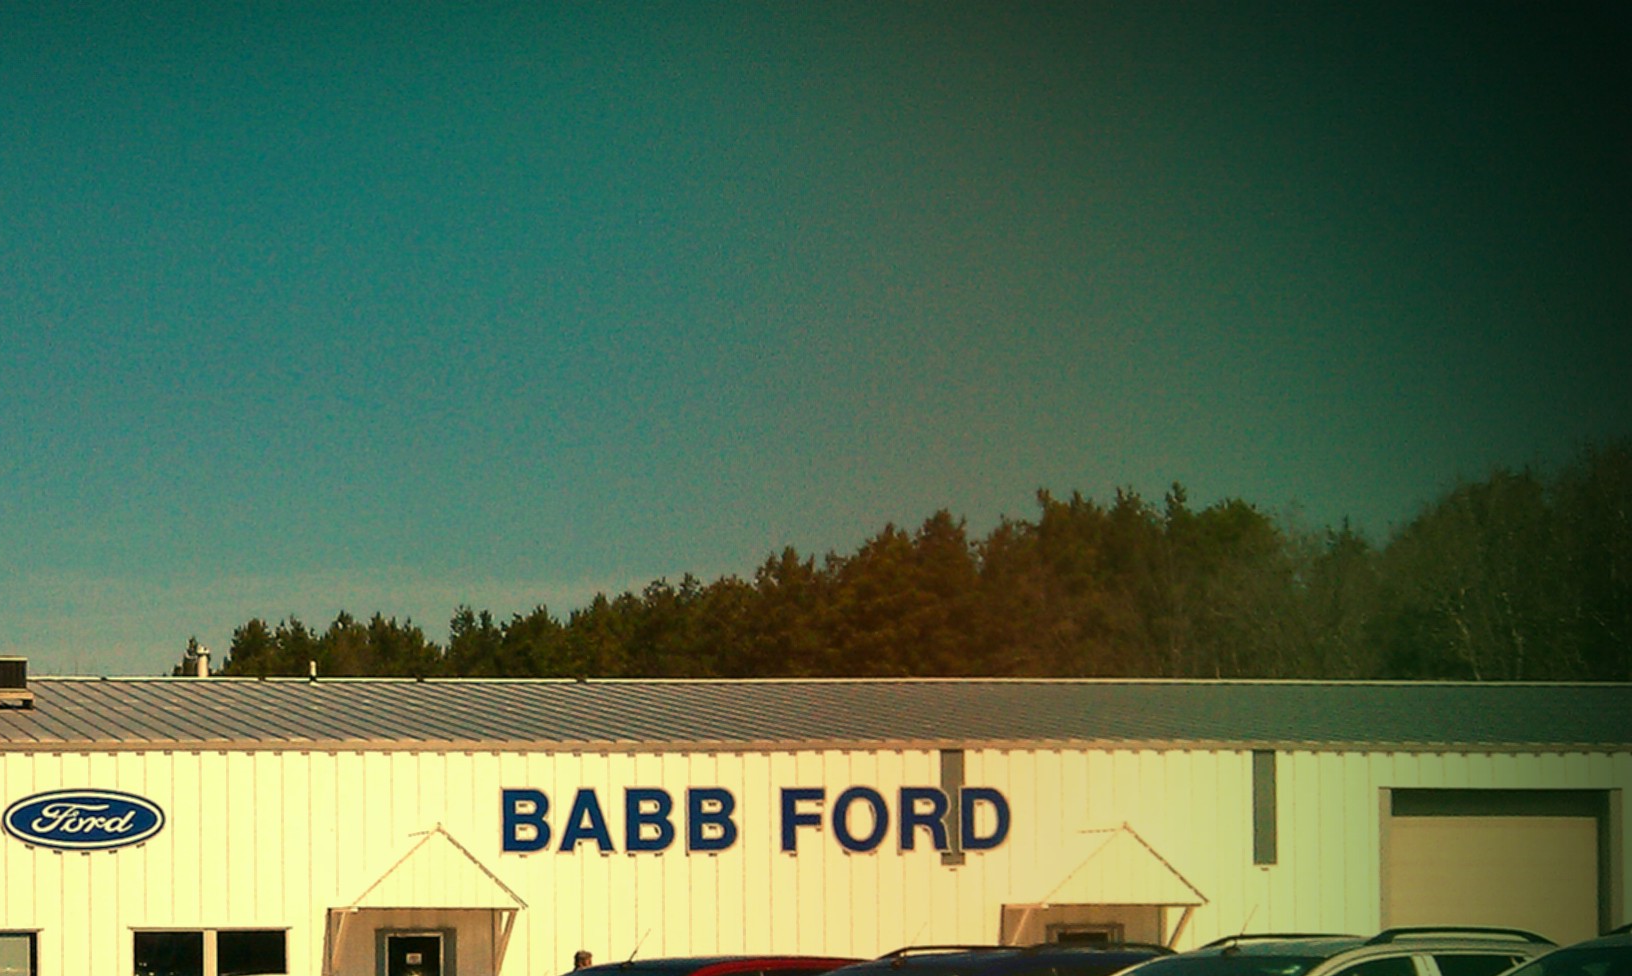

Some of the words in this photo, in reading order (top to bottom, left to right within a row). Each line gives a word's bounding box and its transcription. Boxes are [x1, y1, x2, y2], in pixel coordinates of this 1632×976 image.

[31, 803, 135, 833] Ford
[500, 787, 738, 853] BABB
[779, 787, 1011, 853] FORD
